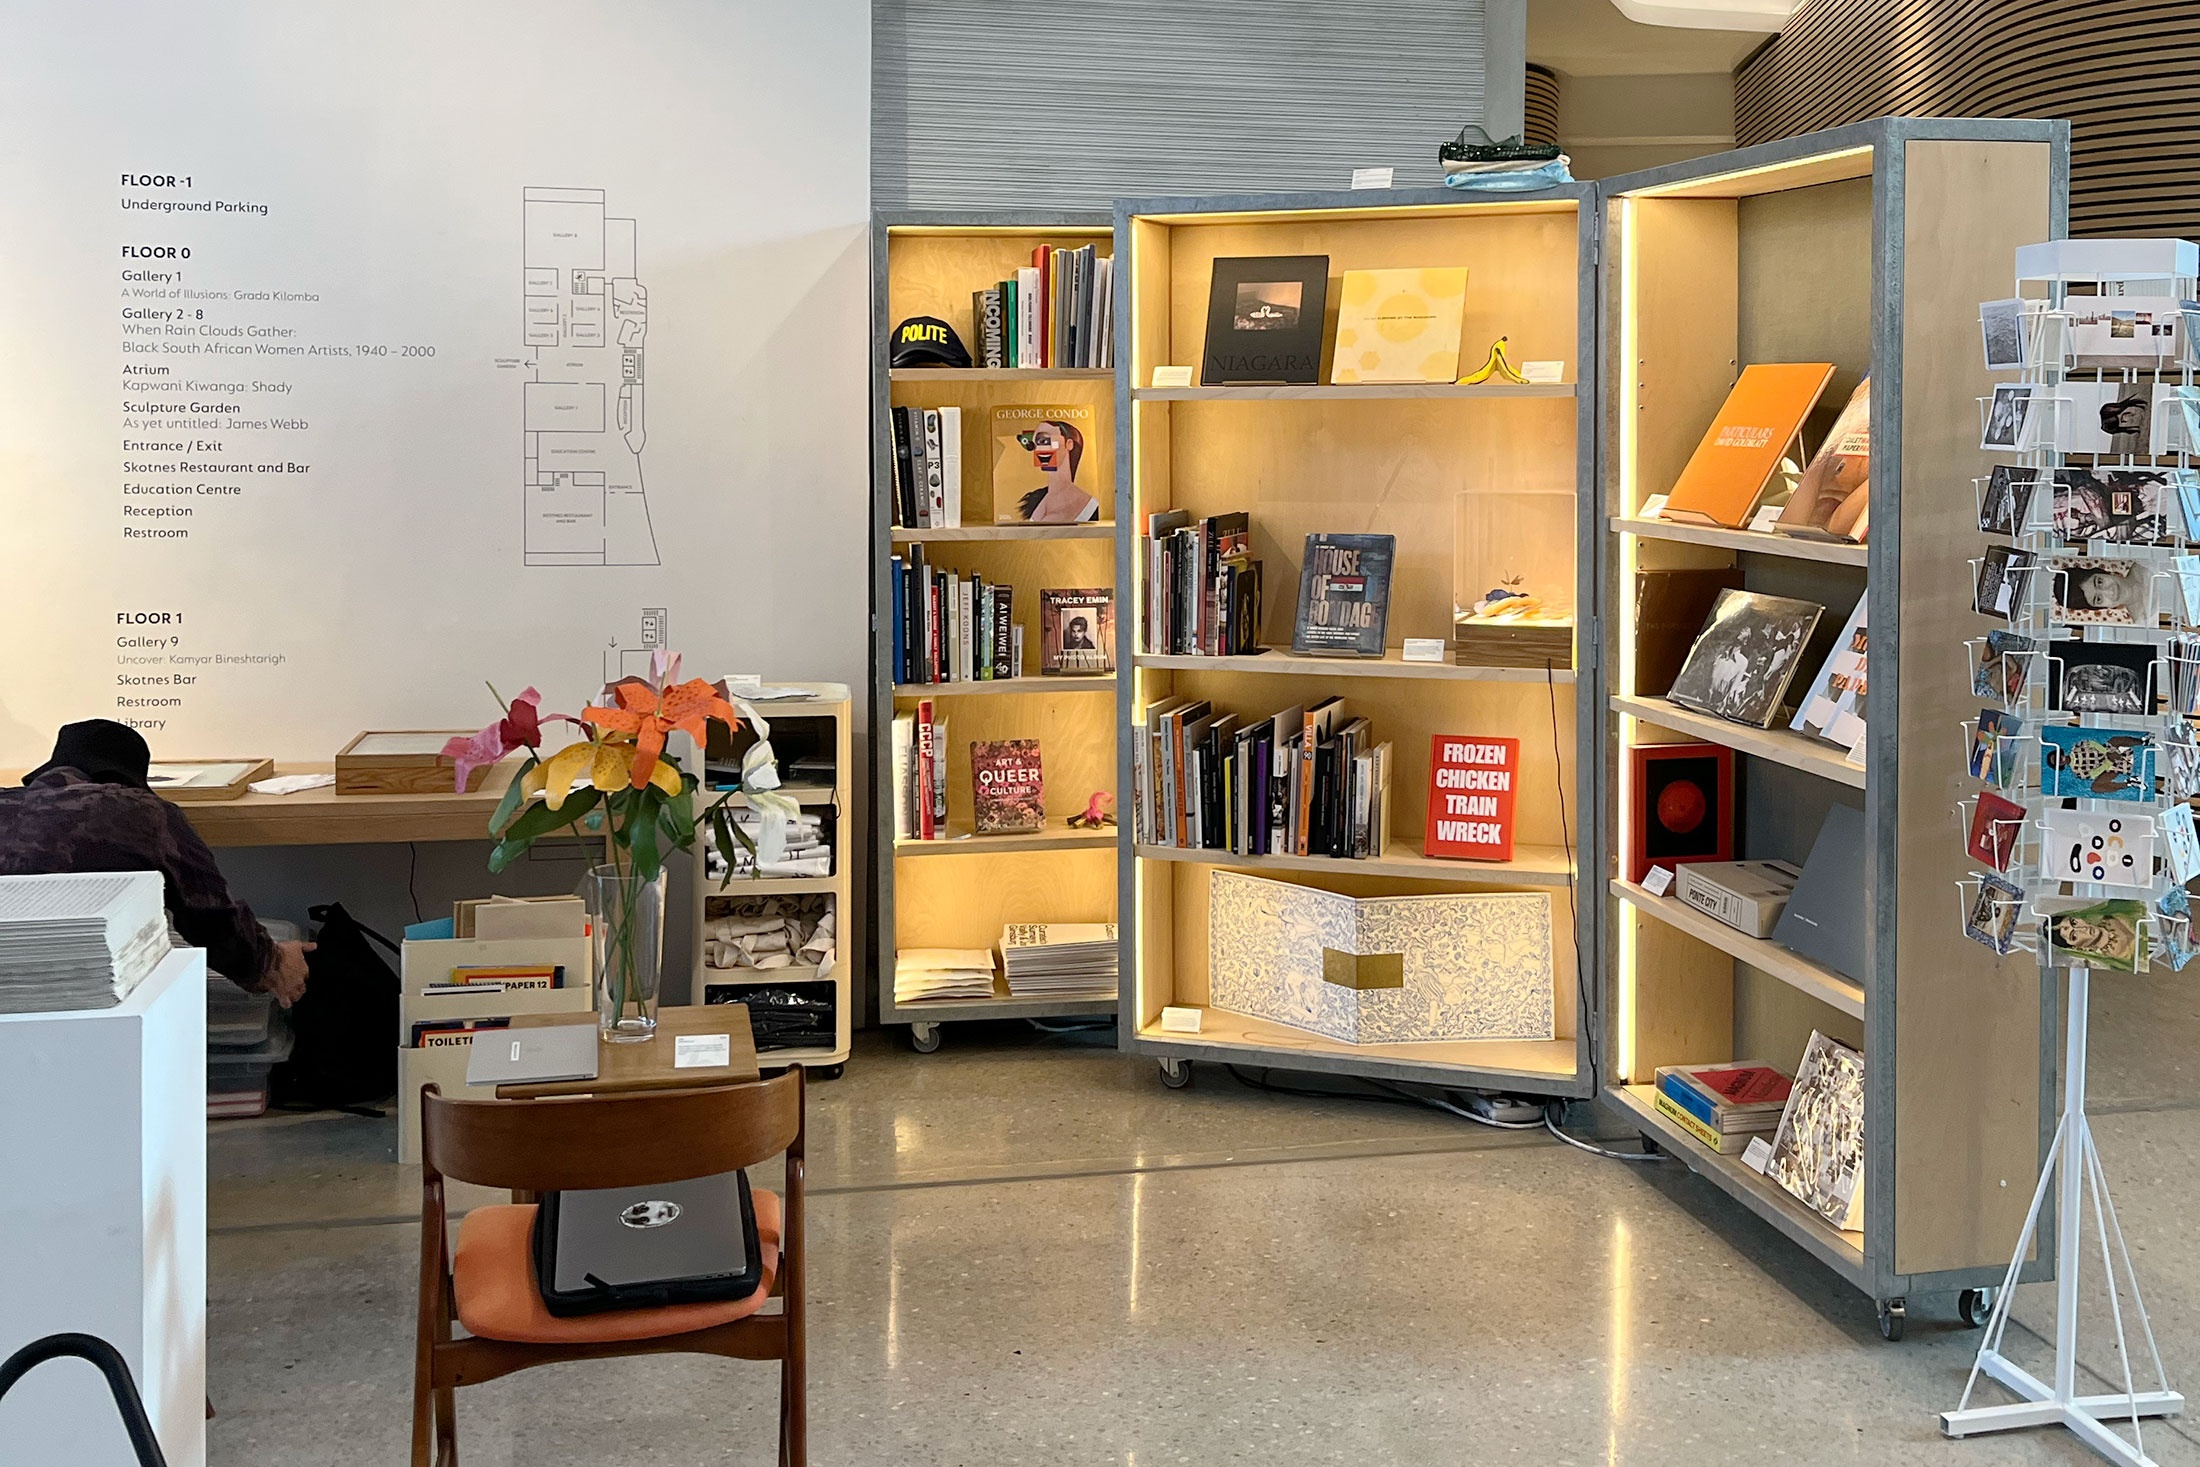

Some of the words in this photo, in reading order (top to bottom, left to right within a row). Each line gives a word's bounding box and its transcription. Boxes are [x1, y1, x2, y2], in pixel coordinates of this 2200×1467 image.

[121, 174, 176, 188] FLOOR
[179, 176, 192, 188] -1
[121, 198, 212, 214] Underground
[215, 200, 268, 217] Parking
[122, 245, 177, 259] FLOOR
[180, 247, 191, 259] 0
[121, 269, 173, 285] Gallery
[175, 271, 181, 282] 1
[120, 287, 130, 298] A
[131, 287, 166, 299] World
[168, 288, 182, 299] of
[183, 289, 231, 300] Illusions:
[233, 289, 270, 301] Grada
[272, 291, 320, 302] Kilomba
[122, 307, 173, 323] Gallery
[176, 308, 184, 320] 2
[195, 308, 204, 321] 8
[121, 323, 162, 336] When
[165, 323, 196, 336] Rain
[198, 324, 244, 337] Clouds
[246, 325, 297, 338] Gather:
[901, 323, 948, 345] POLITE
[985, 289, 1001, 369] INCOMING
[122, 341, 159, 353] Black
[162, 341, 201, 354] South
[203, 341, 253, 355] African
[254, 343, 305, 356] Women
[307, 344, 352, 357] Artists,
[355, 344, 388, 357] 1940
[401, 345, 436, 358] 2000
[122, 363, 170, 375] Atrium
[1210, 355, 1314, 371] NIAGARA
[122, 379, 182, 394] Kapwani
[185, 380, 249, 395] Kiwanga:
[251, 380, 293, 396] Shady
[122, 401, 187, 416] Sculpture
[189, 401, 241, 414] Garden
[996, 408, 1043, 419] GEORGE
[1046, 408, 1089, 419] CONDO
[122, 417, 141, 429] As
[141, 419, 164, 432] yet
[166, 417, 223, 430] untitled:
[225, 417, 268, 430] James
[269, 418, 309, 430] Webb
[1720, 426, 1775, 439] PARTICULARS
[123, 439, 184, 452] Entrance
[186, 440, 193, 455] /
[196, 440, 223, 452] Exit
[1714, 437, 1733, 447] DAVID
[1732, 438, 1769, 448] GOLDBLATT
[123, 461, 176, 473] Skotnes
[180, 461, 254, 473] Restaurant
[257, 462, 284, 473] and
[287, 462, 311, 474] Bar
[927, 461, 940, 469] P3
[123, 483, 193, 495] Education
[196, 483, 242, 495] Centre
[123, 505, 193, 519] Reception
[123, 526, 189, 539] Restroom
[1313, 549, 1360, 576] HOUSE
[1311, 575, 1332, 601] OF
[1050, 596, 1085, 604] TRACEY
[1086, 596, 1109, 604] EMIN
[999, 603, 1007, 613] AI
[117, 612, 171, 625] FLOOR
[175, 612, 182, 624] 1
[116, 636, 168, 650] Gallery
[170, 635, 179, 647] 9
[998, 616, 1007, 656] WEIWEI
[117, 654, 167, 666] Uncover:
[169, 654, 213, 667] Kamyar
[215, 653, 286, 666] Bineshtarigh
[117, 674, 170, 686] Skotnes
[173, 673, 197, 685] Bar
[117, 696, 182, 707] Restroom
[919, 723, 933, 757] CCCP
[1304, 724, 1313, 748] VILLA
[1443, 743, 1506, 765] FROZEN
[995, 758, 1013, 767] ART
[979, 768, 1040, 786] QUEER
[1436, 768, 1510, 791] CHICKEN
[989, 786, 1031, 795] CULTURE
[1446, 794, 1497, 817] TRAIN
[1437, 820, 1502, 845] WRECK
[1688, 888, 1706, 906] PONTE
[1705, 896, 1718, 911] CITY
[505, 981, 535, 990] PAPER
[1658, 1098, 1678, 1117] MAGNUM
[1676, 1111, 1697, 1129] CONTACT
[1695, 1125, 1712, 1142] SHEETS
